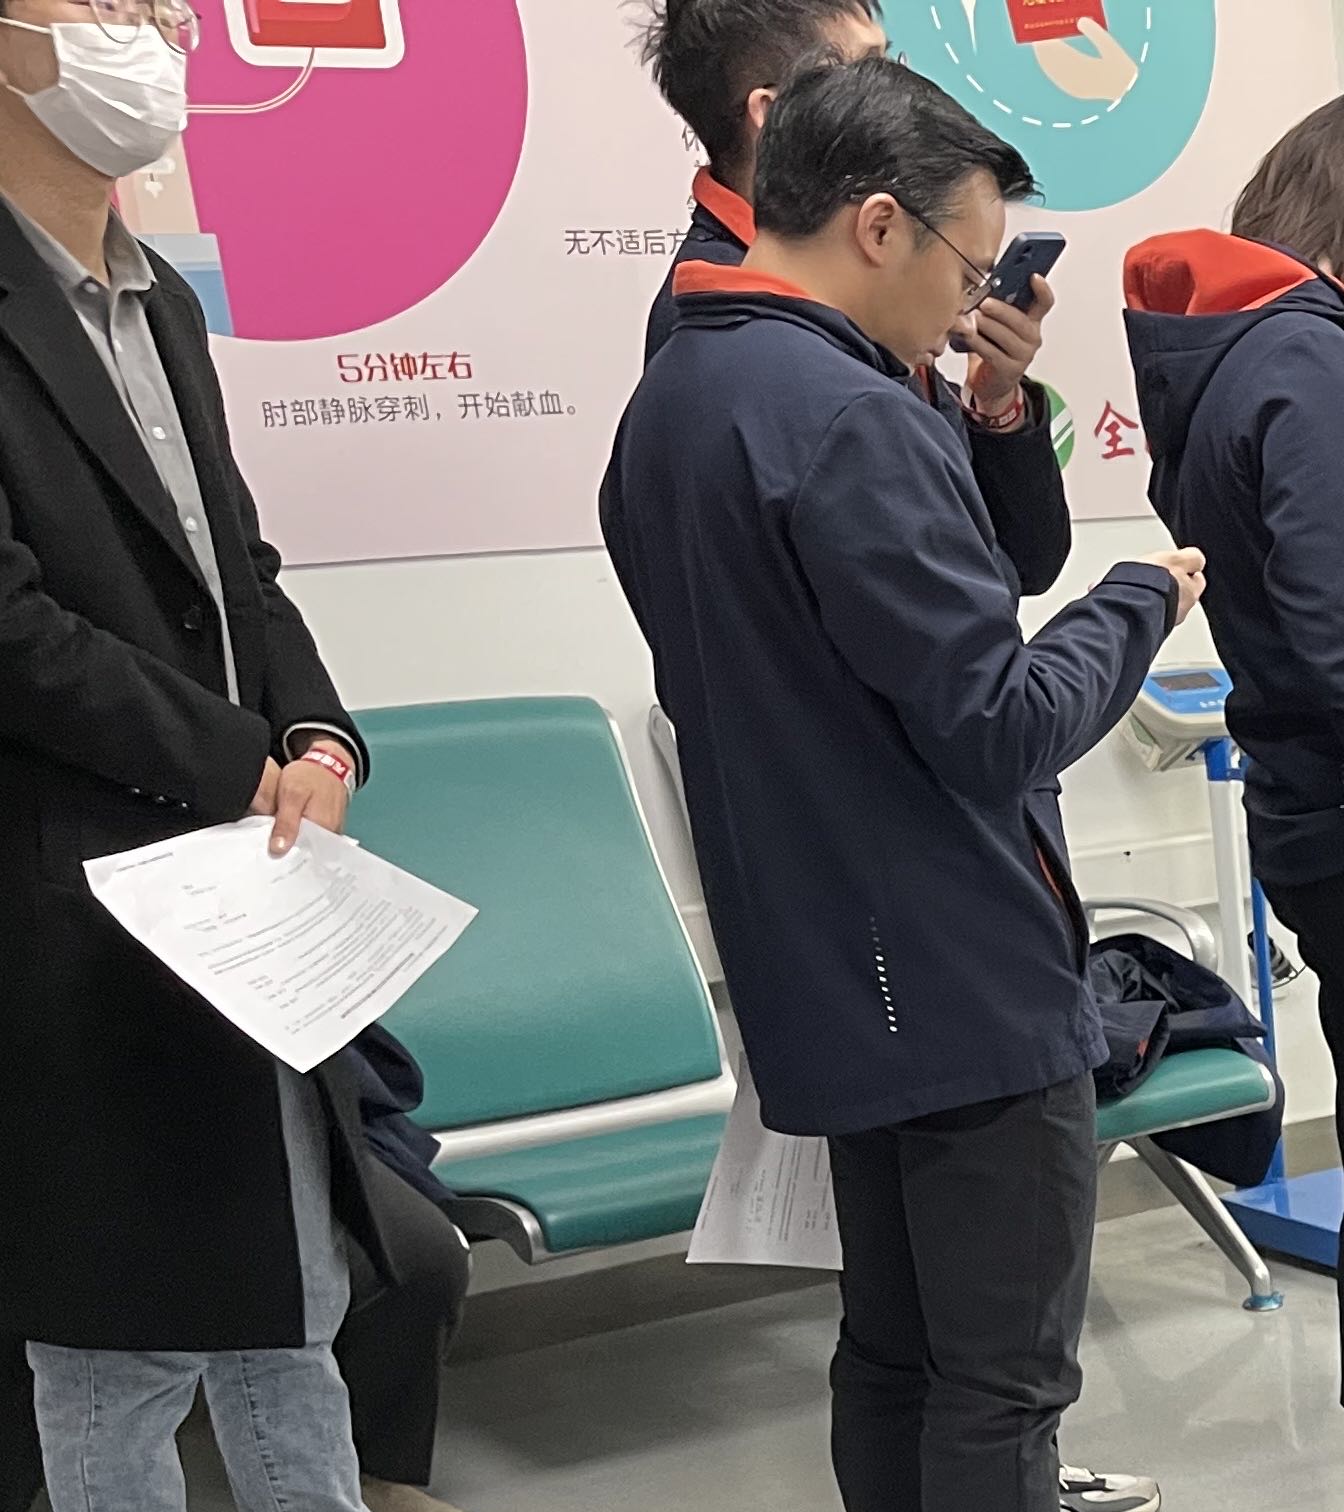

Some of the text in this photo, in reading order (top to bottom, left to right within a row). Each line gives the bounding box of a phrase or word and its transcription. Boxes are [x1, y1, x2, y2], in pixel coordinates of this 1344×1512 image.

[337, 351, 472, 382] 5分钟左右
[261, 389, 577, 428] 肘部静脉穿刺，开始献血。
